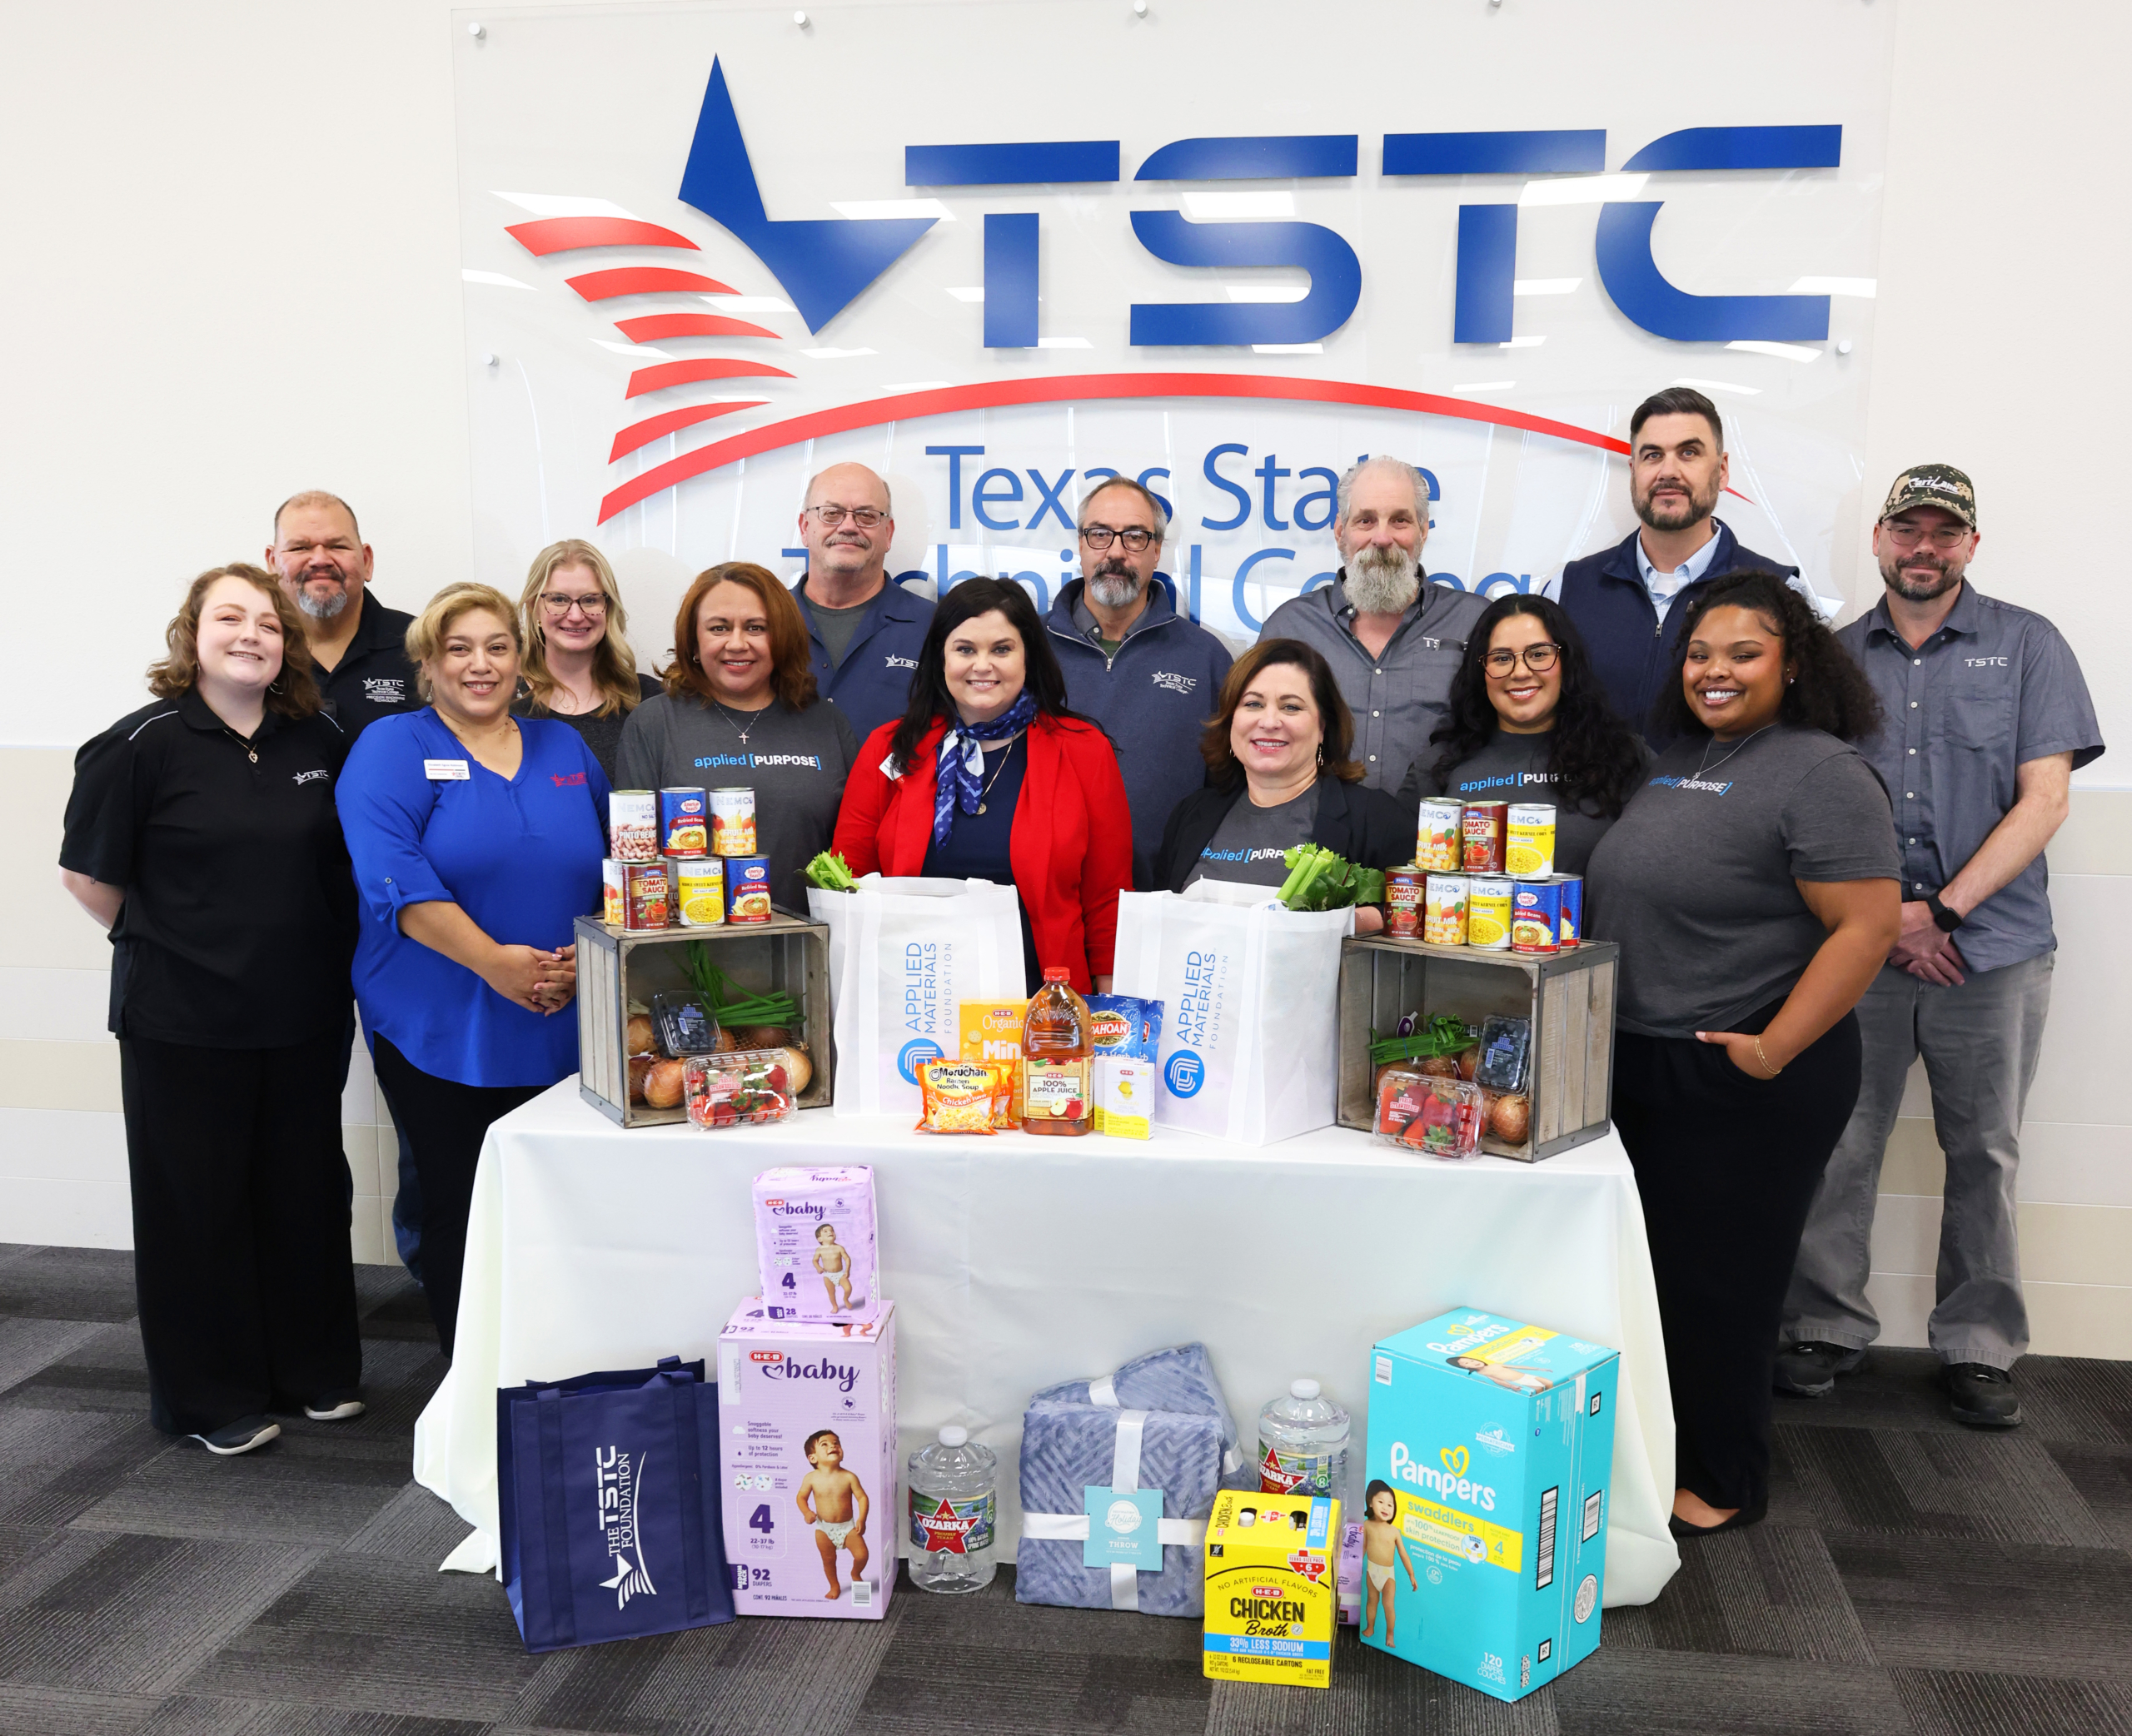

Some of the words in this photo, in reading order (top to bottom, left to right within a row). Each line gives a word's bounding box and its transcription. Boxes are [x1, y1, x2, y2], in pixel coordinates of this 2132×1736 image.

[905, 124, 1843, 348] TSTC
[925, 445, 1173, 531] Texs
[1202, 443, 1441, 531] Sta
[1964, 656, 2008, 668] TSTC
[375, 679, 405, 687] TSTC
[1166, 673, 1197, 686] TSTC
[694, 753, 747, 769] applied
[304, 769, 330, 778] TSTC
[1460, 773, 1514, 792] applied
[619, 831, 639, 839] PINTO
[1433, 842, 1447, 852] MIX
[1426, 916, 1442, 924] FRUIT
[1443, 917, 1457, 925] MIX
[905, 943, 922, 1032] APPLIED
[924, 943, 936, 1033] MATERIALS
[944, 943, 952, 1034] FOUNDATION
[1177, 951, 1202, 1043] APPLIED
[1192, 953, 1216, 1047] MATERIALS
[1209, 955, 1228, 1049] FOUNDATION
[983, 1014, 1024, 1032] Organic
[940, 1067, 988, 1077] Maruchan
[942, 1095, 971, 1106] Chicken
[786, 1201, 826, 1221] baby
[781, 1272, 796, 1289] 4
[745, 1309, 765, 1318] 4
[1426, 1323, 1510, 1355] Pampers
[786, 1356, 860, 1392] baby
[1477, 1434, 1512, 1450] PEDIATRICIAN
[1391, 1441, 1496, 1511] Pampers
[596, 1445, 619, 1530] TSTC
[617, 1453, 633, 1549] FOUNDATION
[750, 1504, 774, 1534] 4
[922, 1518, 970, 1531] OZARKA
[1111, 1514, 1142, 1529] Holiday
[1215, 1508, 1233, 1529] CHICKEN
[1407, 1501, 1474, 1533] swaddlers
[607, 1527, 620, 1557] THE
[1405, 1526, 1419, 1537] skin
[1421, 1533, 1460, 1551] protection
[1433, 1529, 1460, 1541] LEAKPROOF
[1108, 1540, 1138, 1549] THROW
[1494, 1540, 1503, 1555] 4
[1410, 1544, 1435, 1558] protection
[1448, 1557, 1461, 1567] peau
[1425, 1554, 1434, 1563] 100
[752, 1569, 770, 1580] 92
[1218, 1581, 1231, 1590] NO
[1233, 1577, 1278, 1586] ARTIFICIAL
[1282, 1579, 1318, 1598] FLAVORS
[1230, 1597, 1305, 1622] CHICKEN
[1245, 1619, 1288, 1637] Broth
[1230, 1637, 1248, 1649] 33%
[1251, 1639, 1270, 1649] LESS
[1272, 1640, 1303, 1652] SODIUM
[1238, 1657, 1275, 1666] RECLOSEABLE
[1276, 1659, 1303, 1668] CARTONS
[1484, 1652, 1502, 1668] 120
[1477, 1668, 1506, 1684] COUCHES
[1480, 1661, 1503, 1677] DIAPERS
